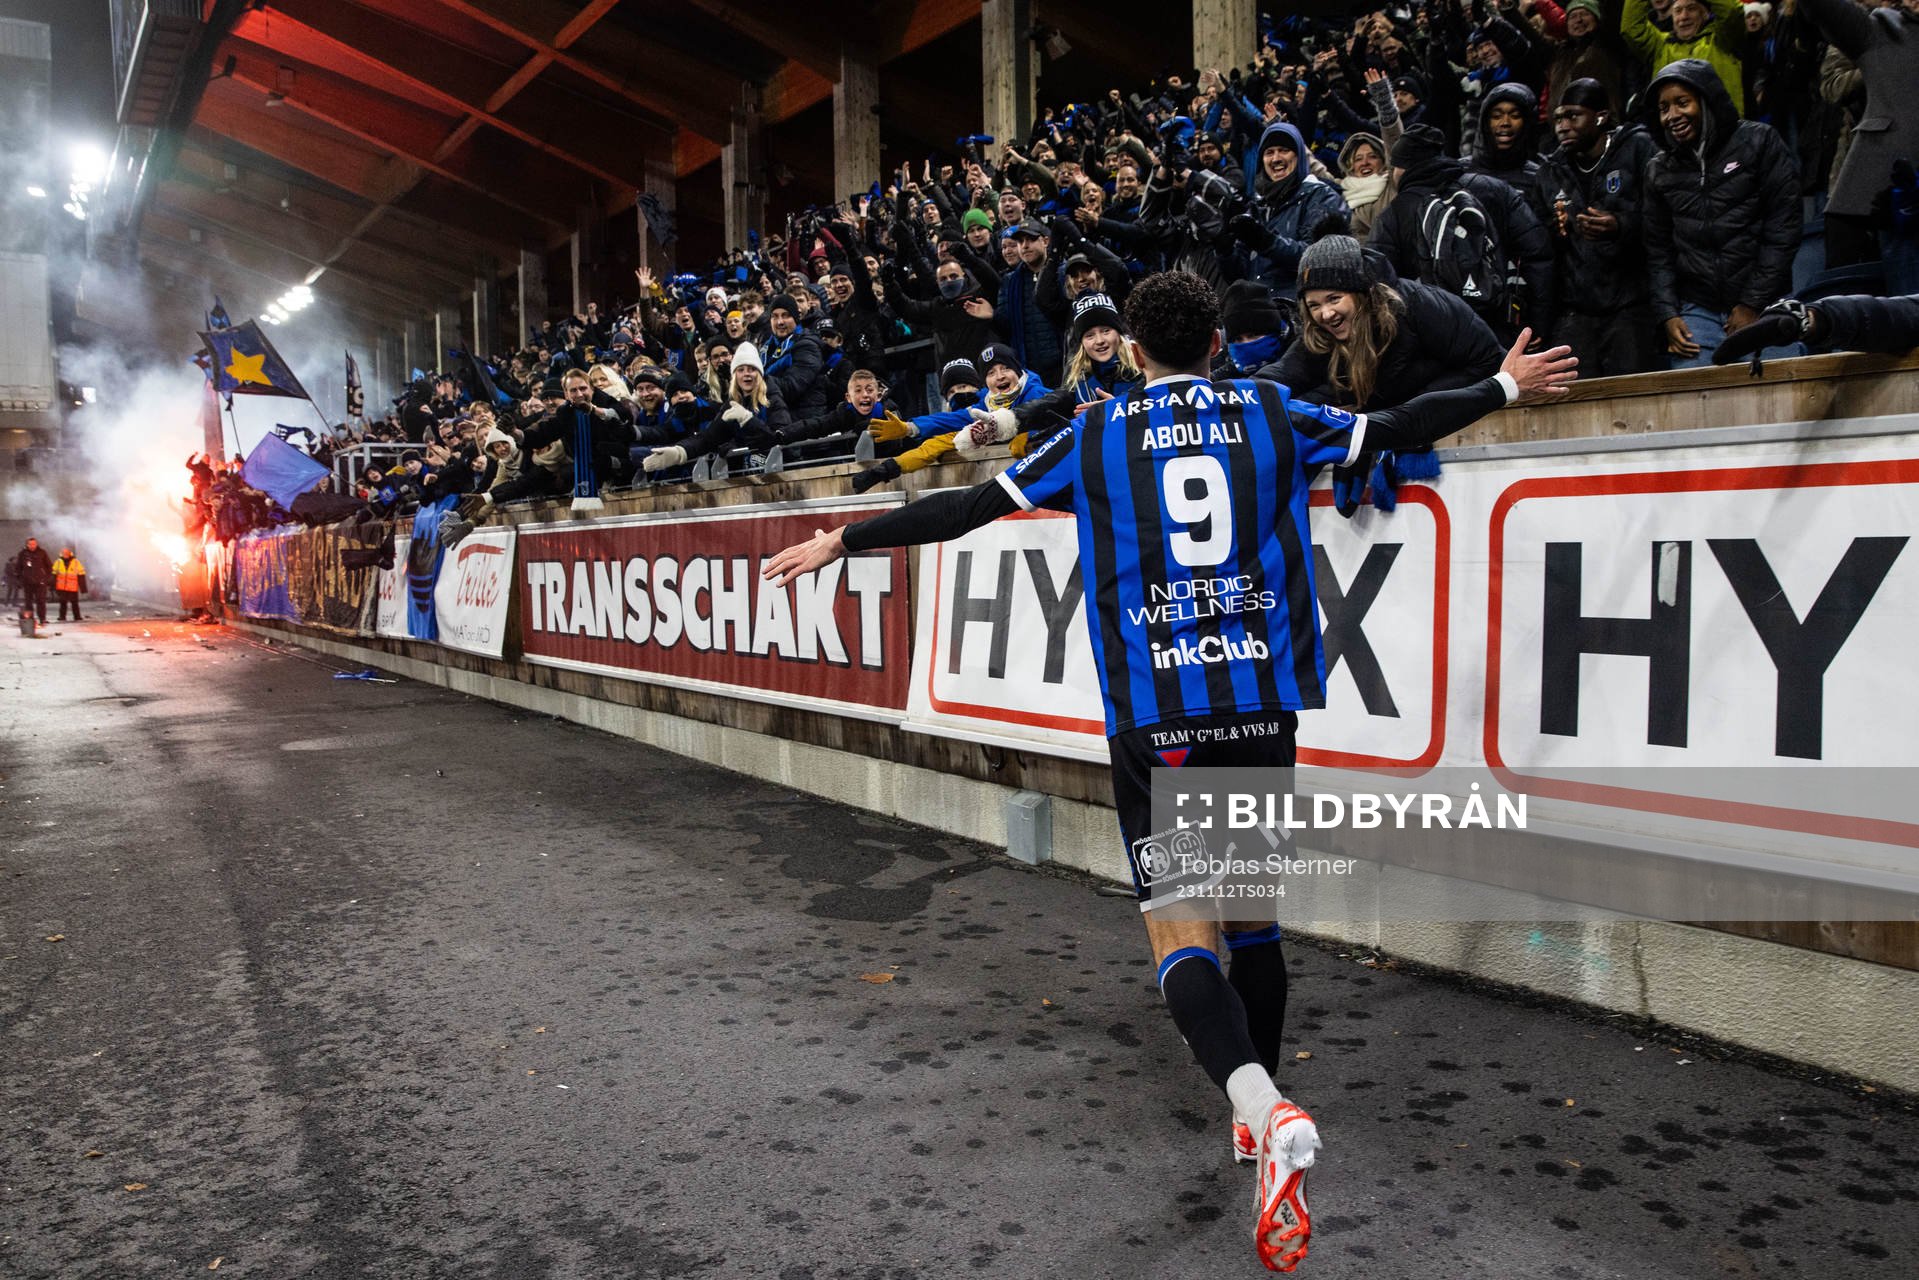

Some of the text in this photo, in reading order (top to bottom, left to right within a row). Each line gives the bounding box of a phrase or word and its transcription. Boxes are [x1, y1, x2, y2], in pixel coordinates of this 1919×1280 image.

[1111, 389, 1259, 422] ÅRSTA TAK
[1141, 422, 1243, 451] ABOU ALI
[1162, 455, 1233, 567] 9
[1150, 575, 1253, 602] NORDIC
[526, 555, 893, 669] TRANSSCHAKT
[1127, 590, 1276, 626] WELLNESS
[1150, 631, 1269, 669] inkClub
[1539, 536, 1911, 761] HY
[1151, 730, 1190, 747] TEAM
[1214, 728, 1229, 741] EL
[1229, 726, 1240, 739] &
[1242, 722, 1265, 738] VVS
[1266, 722, 1280, 735] AB
